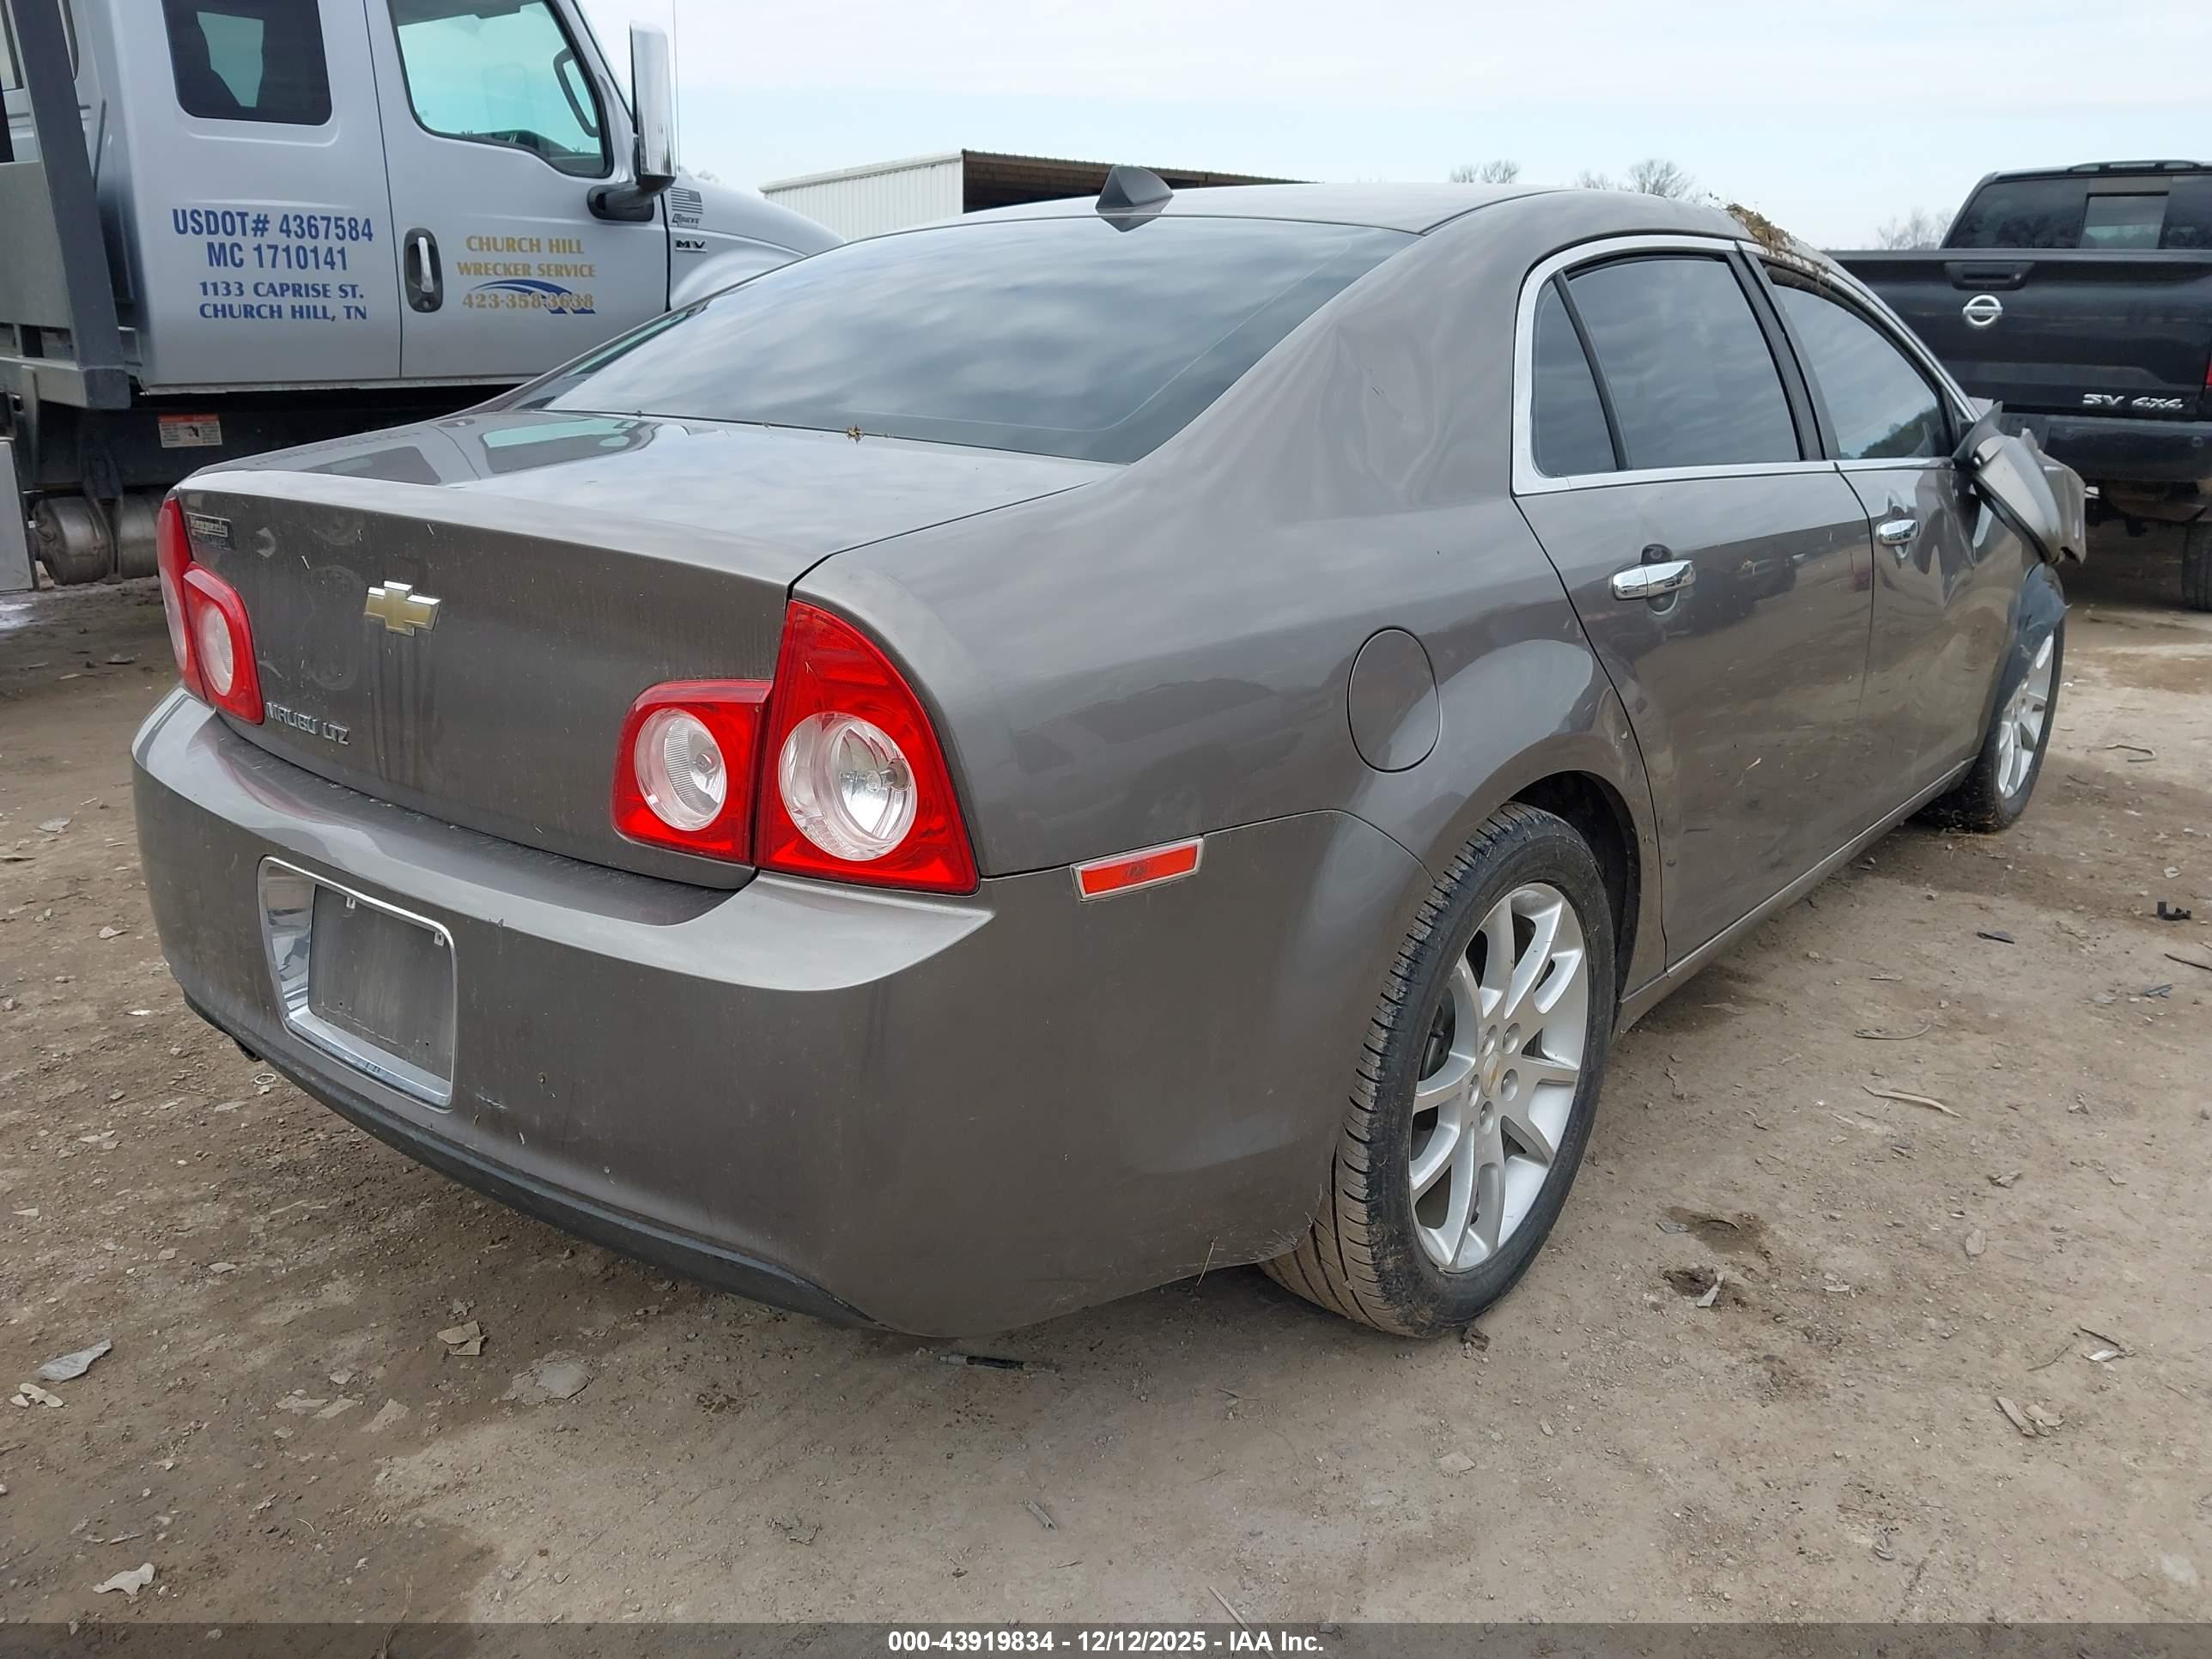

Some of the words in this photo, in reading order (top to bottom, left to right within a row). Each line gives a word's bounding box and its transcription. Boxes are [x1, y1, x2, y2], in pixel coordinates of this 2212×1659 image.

[173, 209, 270, 238] USDOT#
[279, 214, 374, 241] 4367584
[466, 235, 541, 253] CHURCH
[548, 238, 585, 254] HILL
[675, 240, 707, 249] MV
[206, 241, 245, 268] MC
[252, 243, 347, 270] 1710141
[457, 261, 532, 276] WRECKER
[537, 263, 596, 277] SERVICE
[199, 281, 245, 297] 1133
[252, 282, 331, 298] CAPRISE
[337, 283, 364, 299] ST.
[462, 293, 594, 309] 423-358-3638
[199, 303, 283, 319] CHURCH
[290, 305, 336, 322] HILL,
[343, 305, 368, 320] TN
[2082, 393, 2125, 406] SV
[265, 702, 317, 735] MALIBU
[323, 722, 350, 745] LTZ
